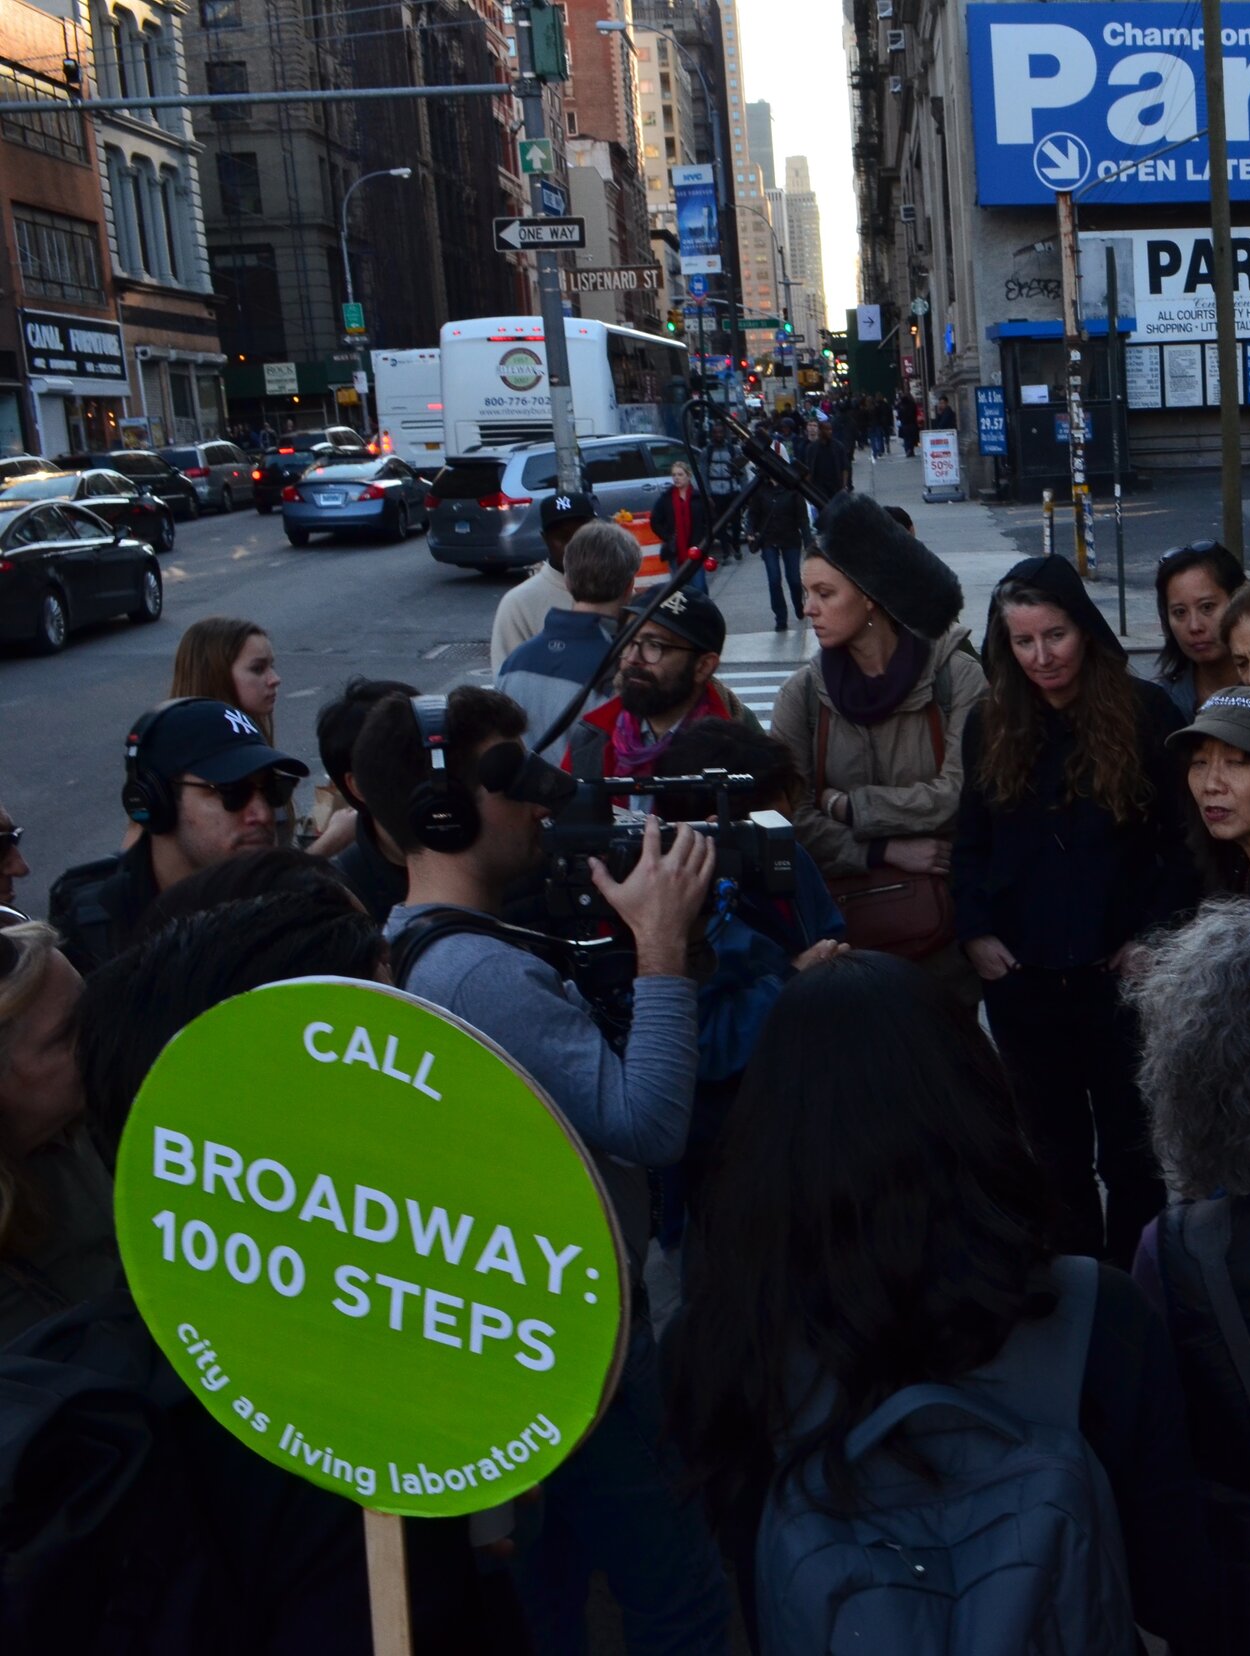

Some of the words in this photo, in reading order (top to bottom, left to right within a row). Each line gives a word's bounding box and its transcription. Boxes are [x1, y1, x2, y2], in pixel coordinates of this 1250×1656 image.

[1097, 159, 1177, 182] OPEN
[519, 227, 544, 240] ONE
[550, 227, 575, 240] WAY
[570, 271, 637, 291] LISPENARD
[643, 270, 659, 288] ST
[1158, 311, 1174, 321] ALL
[1177, 309, 1216, 321] COURTS
[26, 322, 64, 351] CANAL
[1146, 322, 1193, 334] SHOPPING
[484, 397, 552, 407] 800-776-702
[980, 418, 1003, 431] 29.57
[931, 461, 953, 470] 50%
[223, 708, 258, 735] NY
[302, 1020, 443, 1102] CALL
[152, 1126, 600, 1305] BROADWAY:
[151, 1210, 306, 1297] 1000
[332, 1265, 558, 1373] STEPS
[175, 1321, 232, 1394] city
[231, 1395, 271, 1434] as
[279, 1423, 379, 1496] living
[388, 1413, 562, 1497] laboratory
